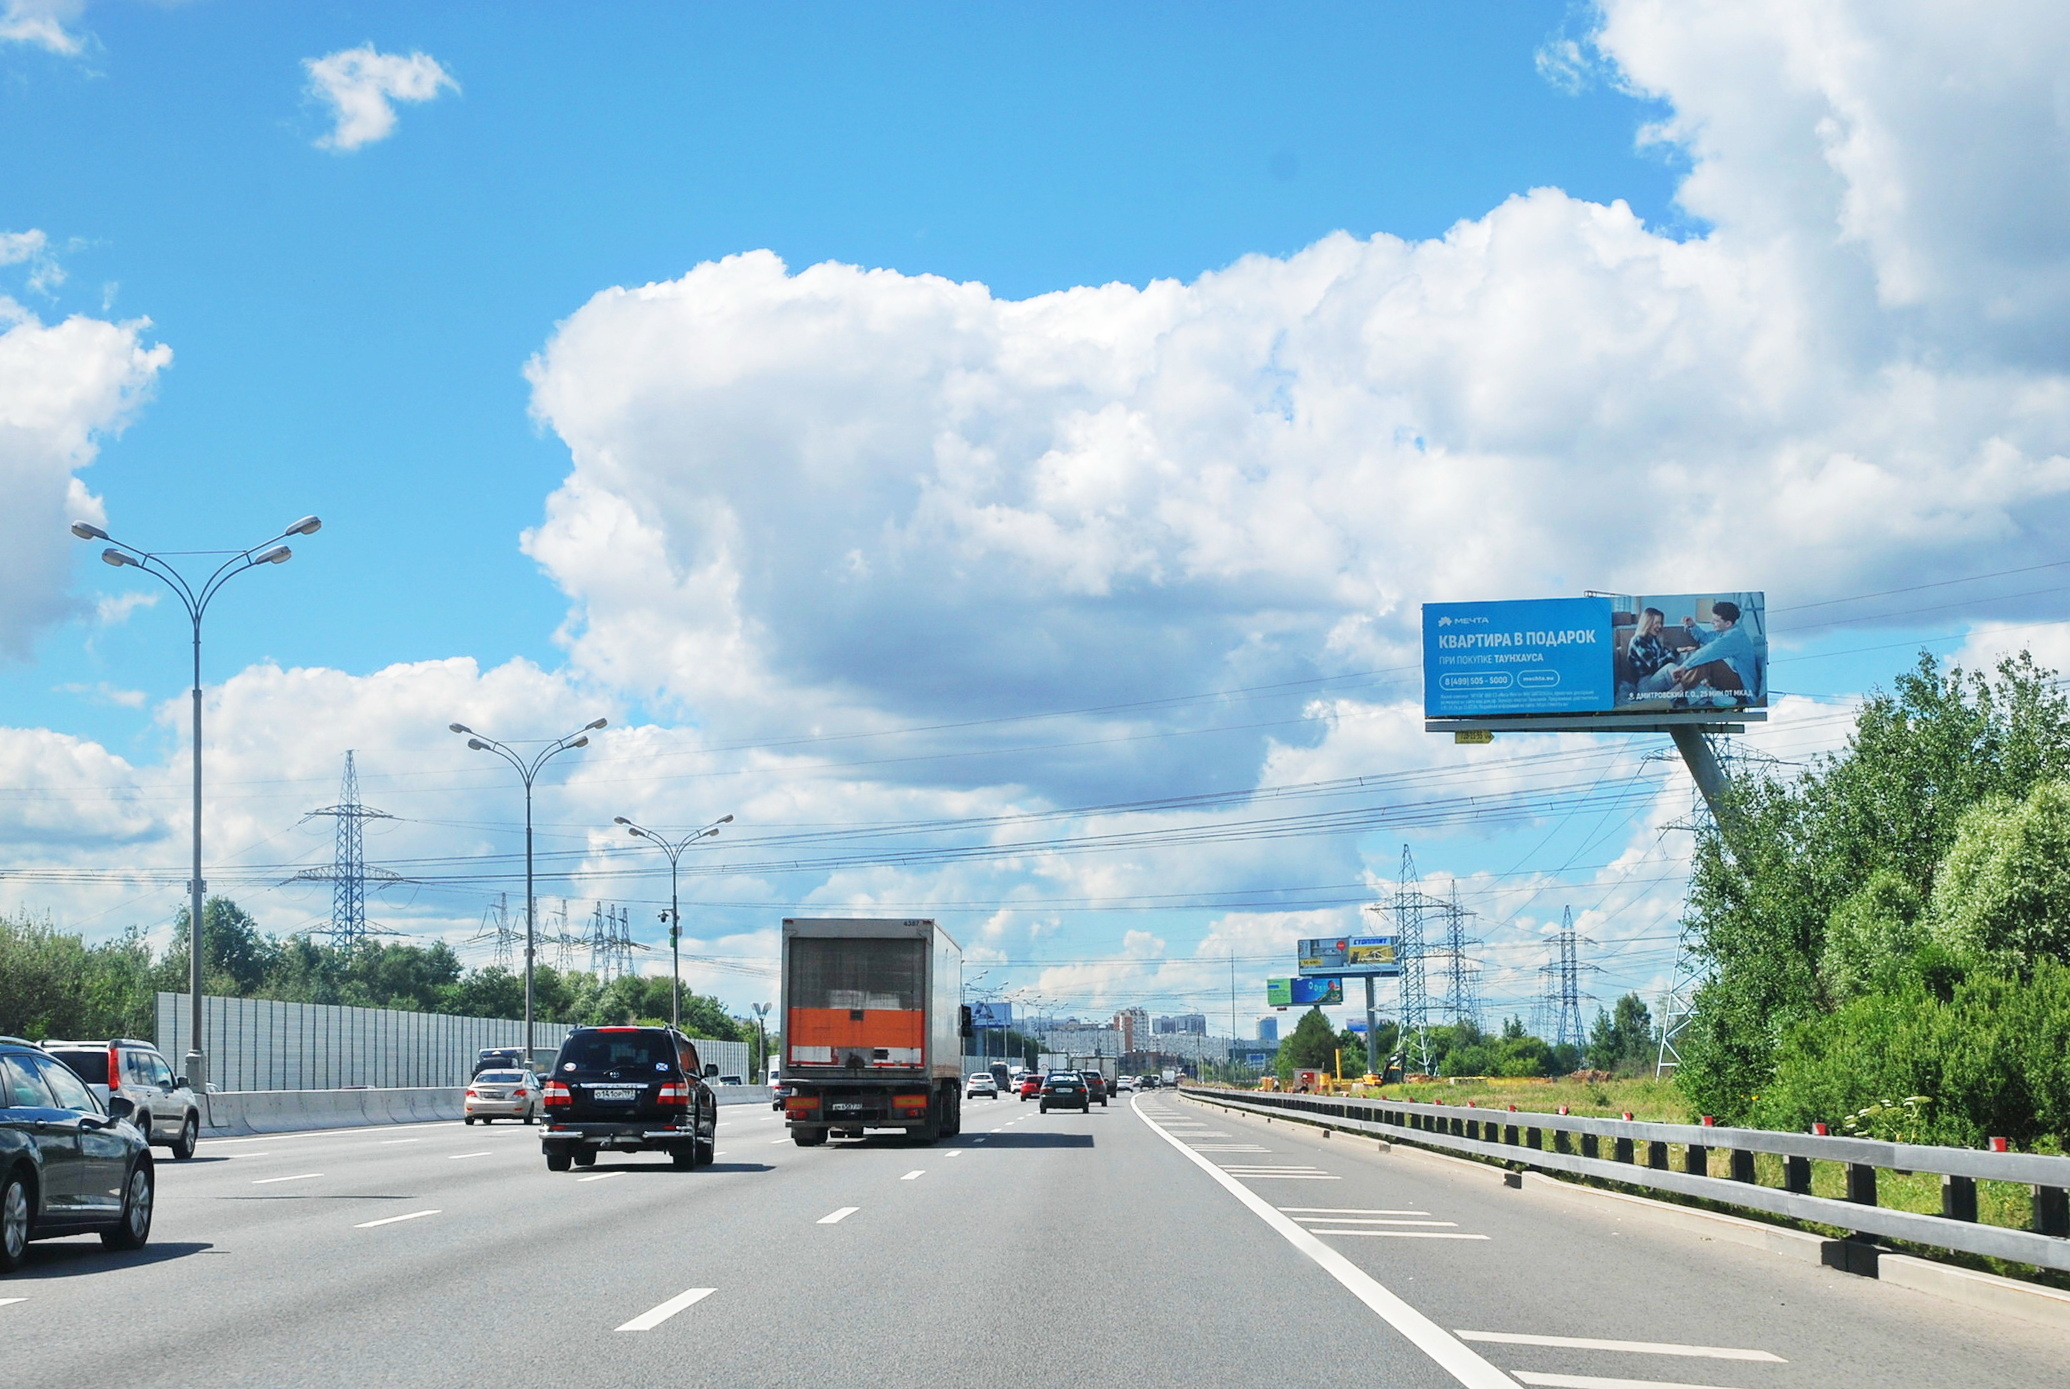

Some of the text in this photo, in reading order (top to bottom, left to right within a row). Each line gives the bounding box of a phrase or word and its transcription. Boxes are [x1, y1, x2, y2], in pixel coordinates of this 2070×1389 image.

[1454, 616, 1489, 625] МЕЧТА
[1438, 629, 1596, 649] КВАРТИРА В ПОДАРОК
[1439, 653, 1544, 665] ПРИ ПОКУПКЕ ТАУНХАУСА
[1444, 678, 1450, 686] 8
[1470, 676, 1484, 685] 505
[1489, 676, 1508, 684] 5000
[1734, 689, 1754, 697] МКАД
